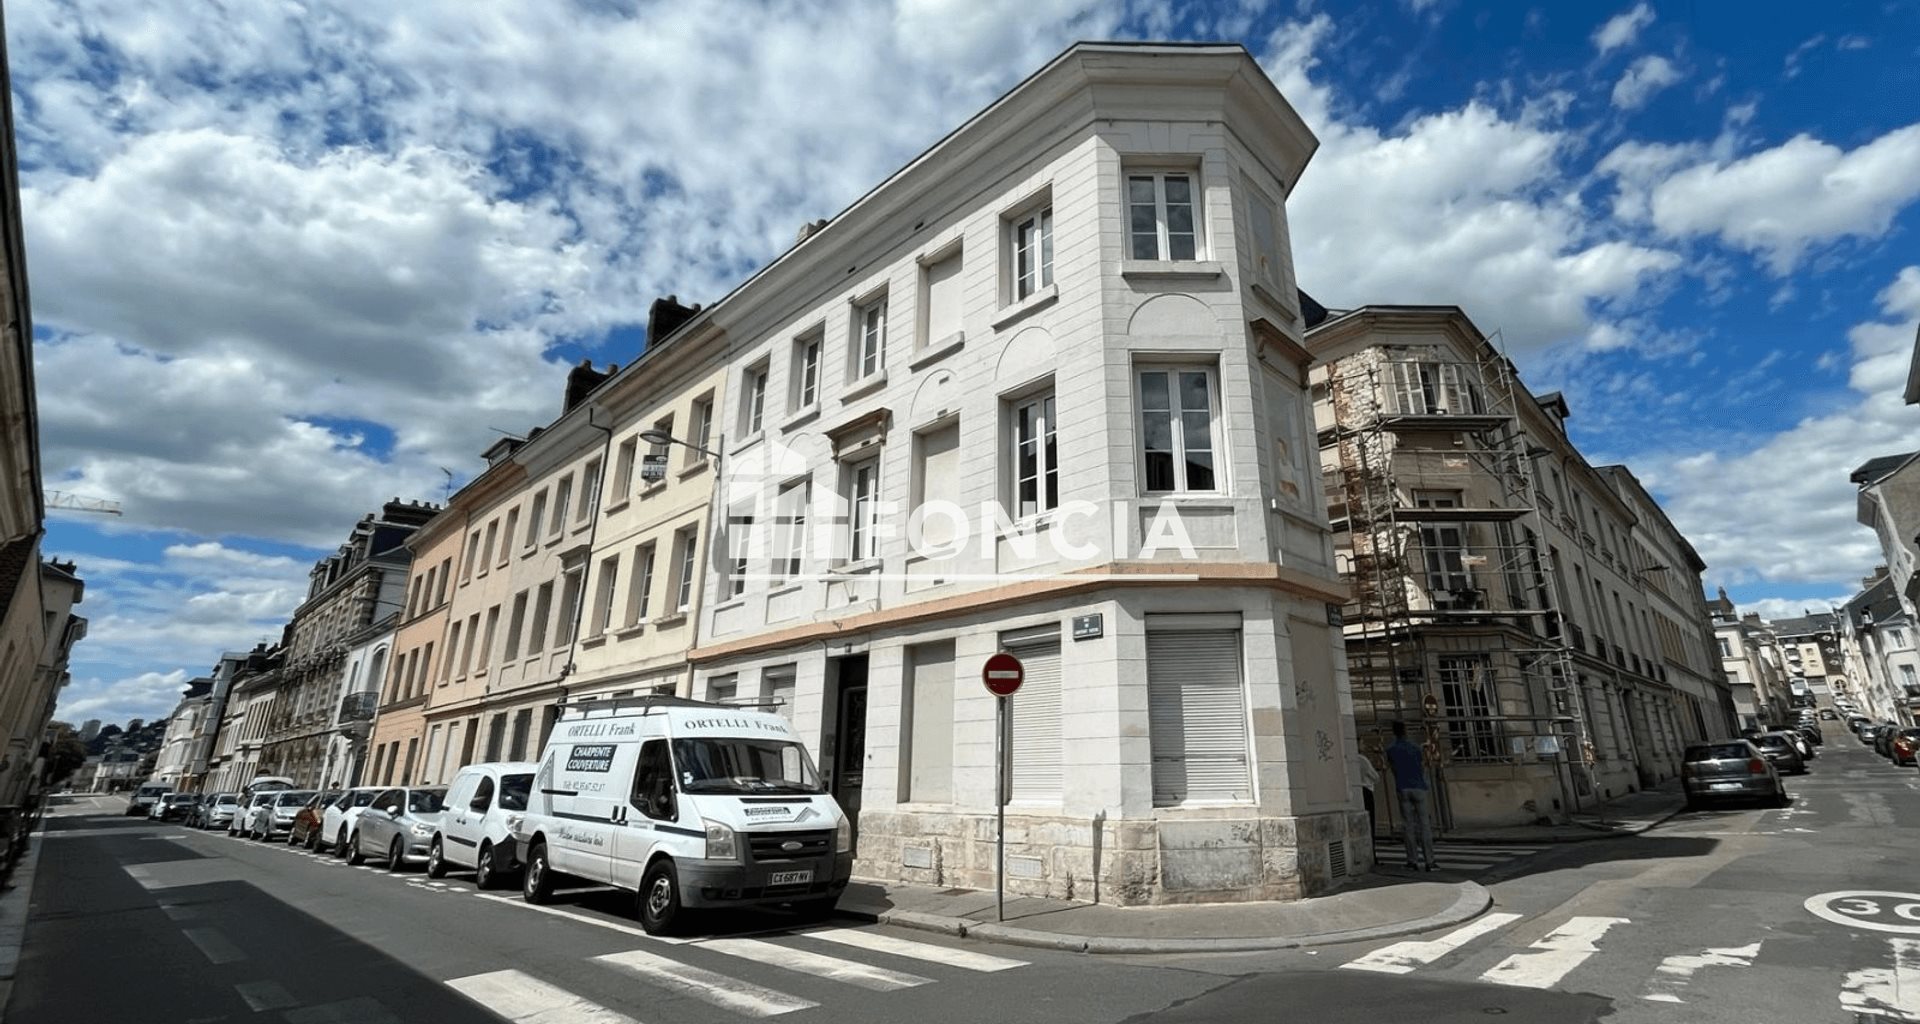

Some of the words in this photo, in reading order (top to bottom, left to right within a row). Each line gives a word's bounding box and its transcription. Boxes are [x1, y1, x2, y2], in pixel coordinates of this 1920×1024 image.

[567, 723, 606, 737] ORTELLI
[608, 722, 636, 736] Frank
[684, 719, 749, 730] ORTELLI
[573, 746, 613, 757] CHARPENTE
[567, 759, 611, 771] COUVERTURE
